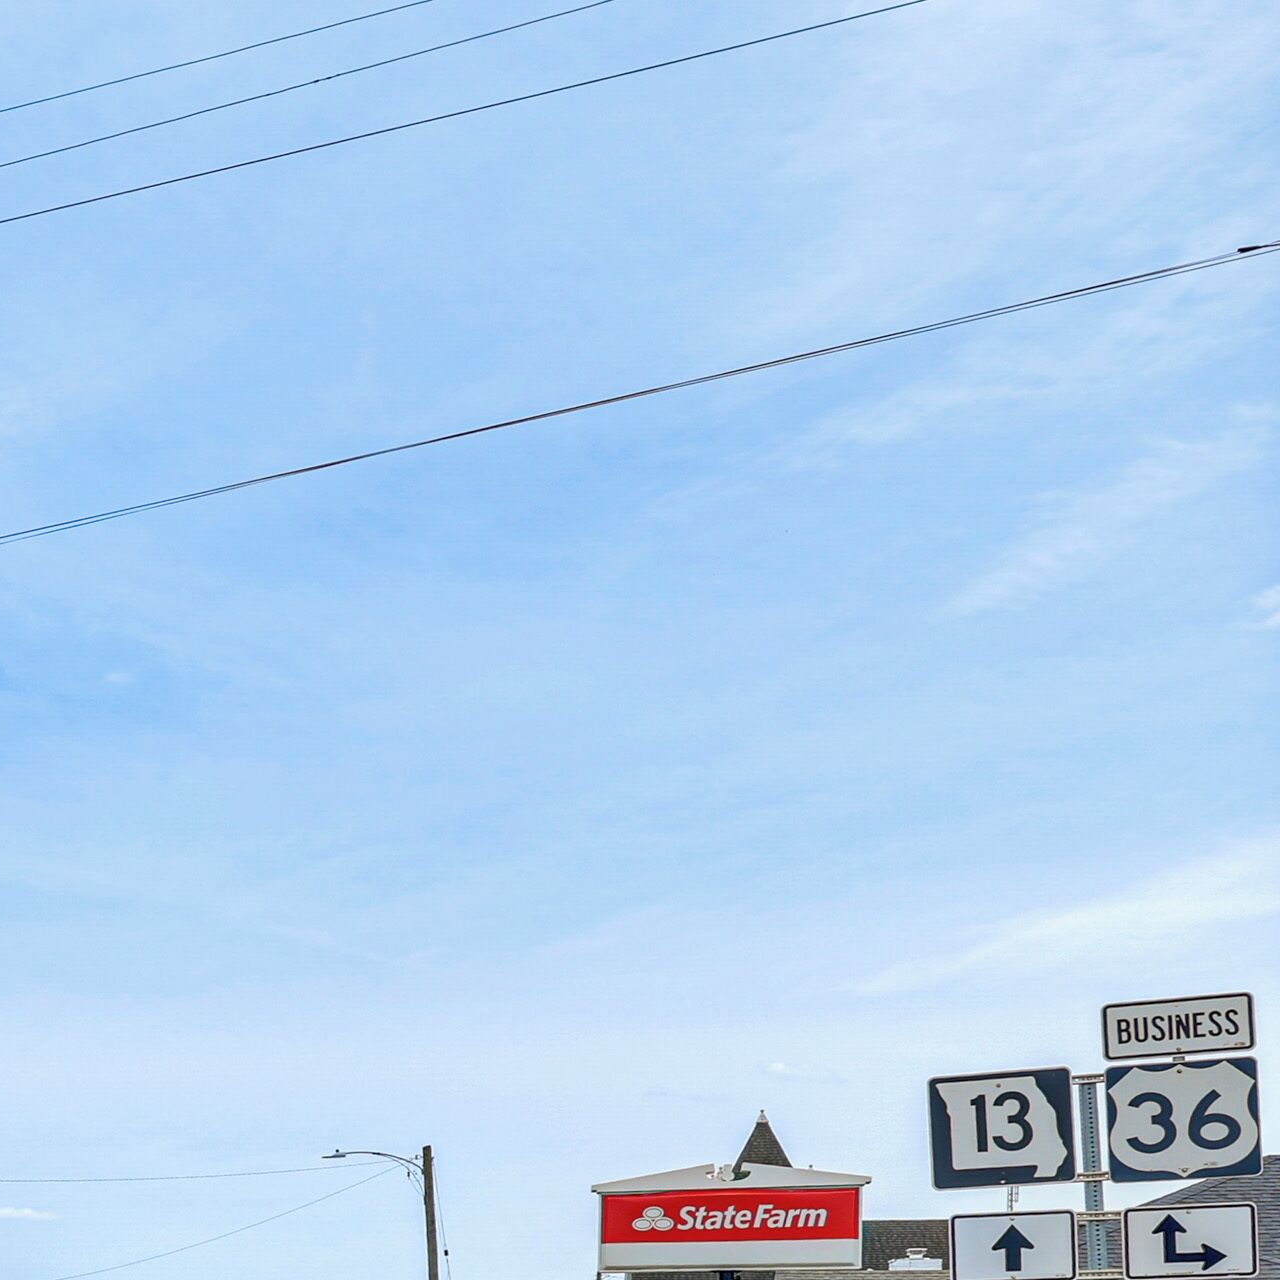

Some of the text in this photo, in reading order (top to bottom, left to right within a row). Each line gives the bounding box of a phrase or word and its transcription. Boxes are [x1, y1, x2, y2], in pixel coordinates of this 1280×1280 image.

[1116, 1009, 1240, 1044] BUSINESS
[970, 1091, 1034, 1153] 13
[1126, 1089, 1241, 1154] 36
